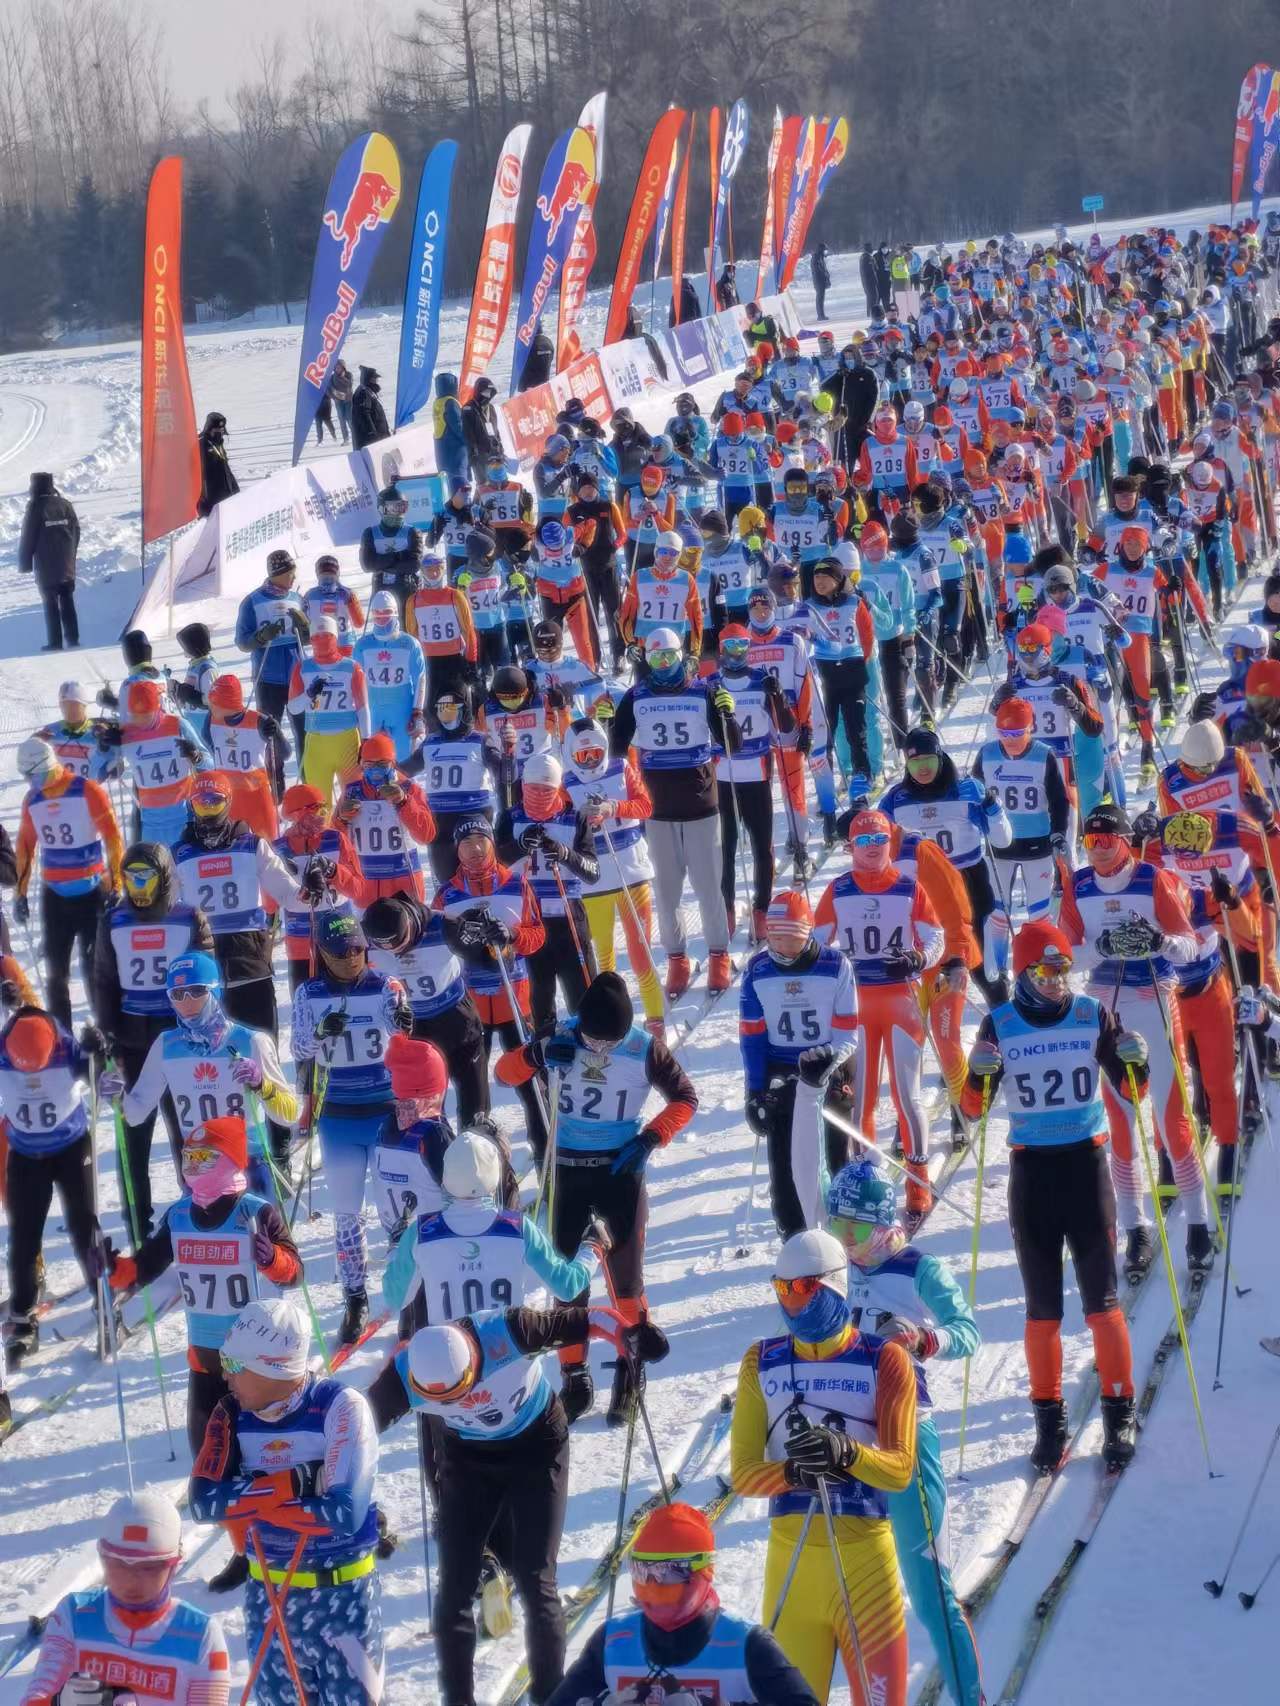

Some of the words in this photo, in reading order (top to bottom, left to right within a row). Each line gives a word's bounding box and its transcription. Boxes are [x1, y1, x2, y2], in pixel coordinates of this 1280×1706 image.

[422, 242, 435, 284] NCI
[154, 284, 166, 333] NCI
[304, 280, 358, 389] RedBull
[412, 287, 433, 370] 新华保险
[986, 393, 1010, 408] 375
[875, 458, 902, 474] 209
[446, 532, 465, 545] 29
[780, 530, 812, 546] 495
[470, 594, 500, 611] 544
[643, 600, 679, 615] 211
[421, 622, 455, 642] 166
[652, 722, 690, 746] 35
[137, 758, 180, 786] 144
[431, 764, 463, 789] 90
[41, 823, 74, 846] 68
[354, 826, 403, 851] 106
[198, 881, 239, 912] 28
[844, 925, 904, 960] 104
[130, 956, 168, 986] 25
[777, 1009, 821, 1042] 45
[1024, 1043, 1045, 1057] NCI
[1047, 1039, 1091, 1054] 新华保险
[1014, 1065, 1092, 1108] 520
[16, 1102, 57, 1129] 46
[177, 1092, 244, 1127] 208
[558, 1083, 629, 1123] 521
[179, 1243, 237, 1262] 中国劲酒
[177, 1272, 250, 1310] 570
[439, 1277, 512, 1321] 109
[782, 1379, 810, 1393] NCI
[812, 1378, 870, 1393] 新华保险
[260, 1455, 291, 1465] RedBull
